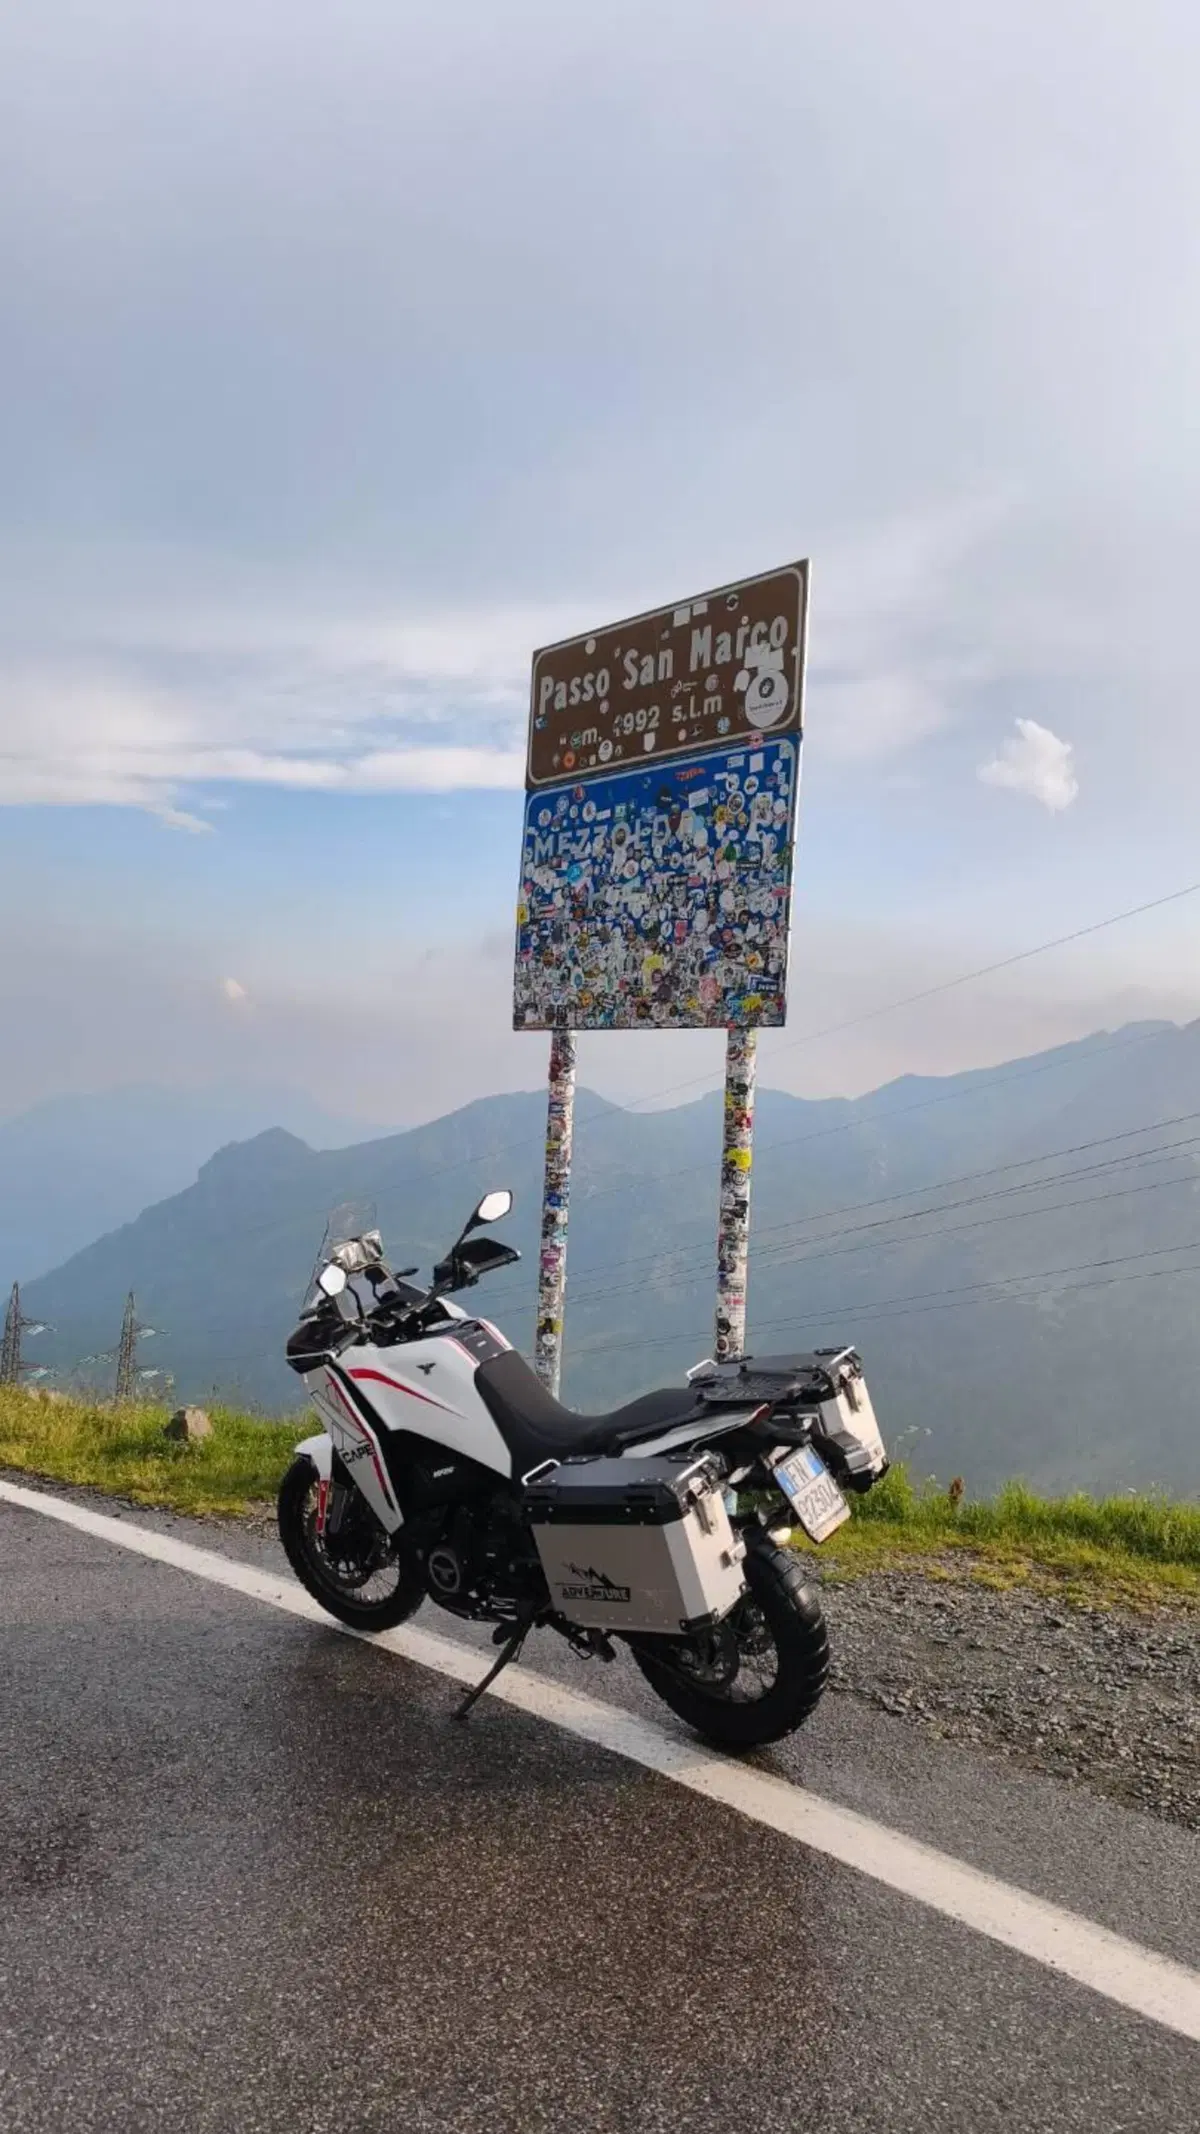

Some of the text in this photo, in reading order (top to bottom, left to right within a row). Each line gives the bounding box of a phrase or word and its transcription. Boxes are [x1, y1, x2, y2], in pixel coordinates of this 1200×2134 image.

[539, 667, 611, 715] Passo
[622, 648, 674, 690] San
[689, 615, 789, 673] Marco
[341, 1443, 377, 1464] CAPE
